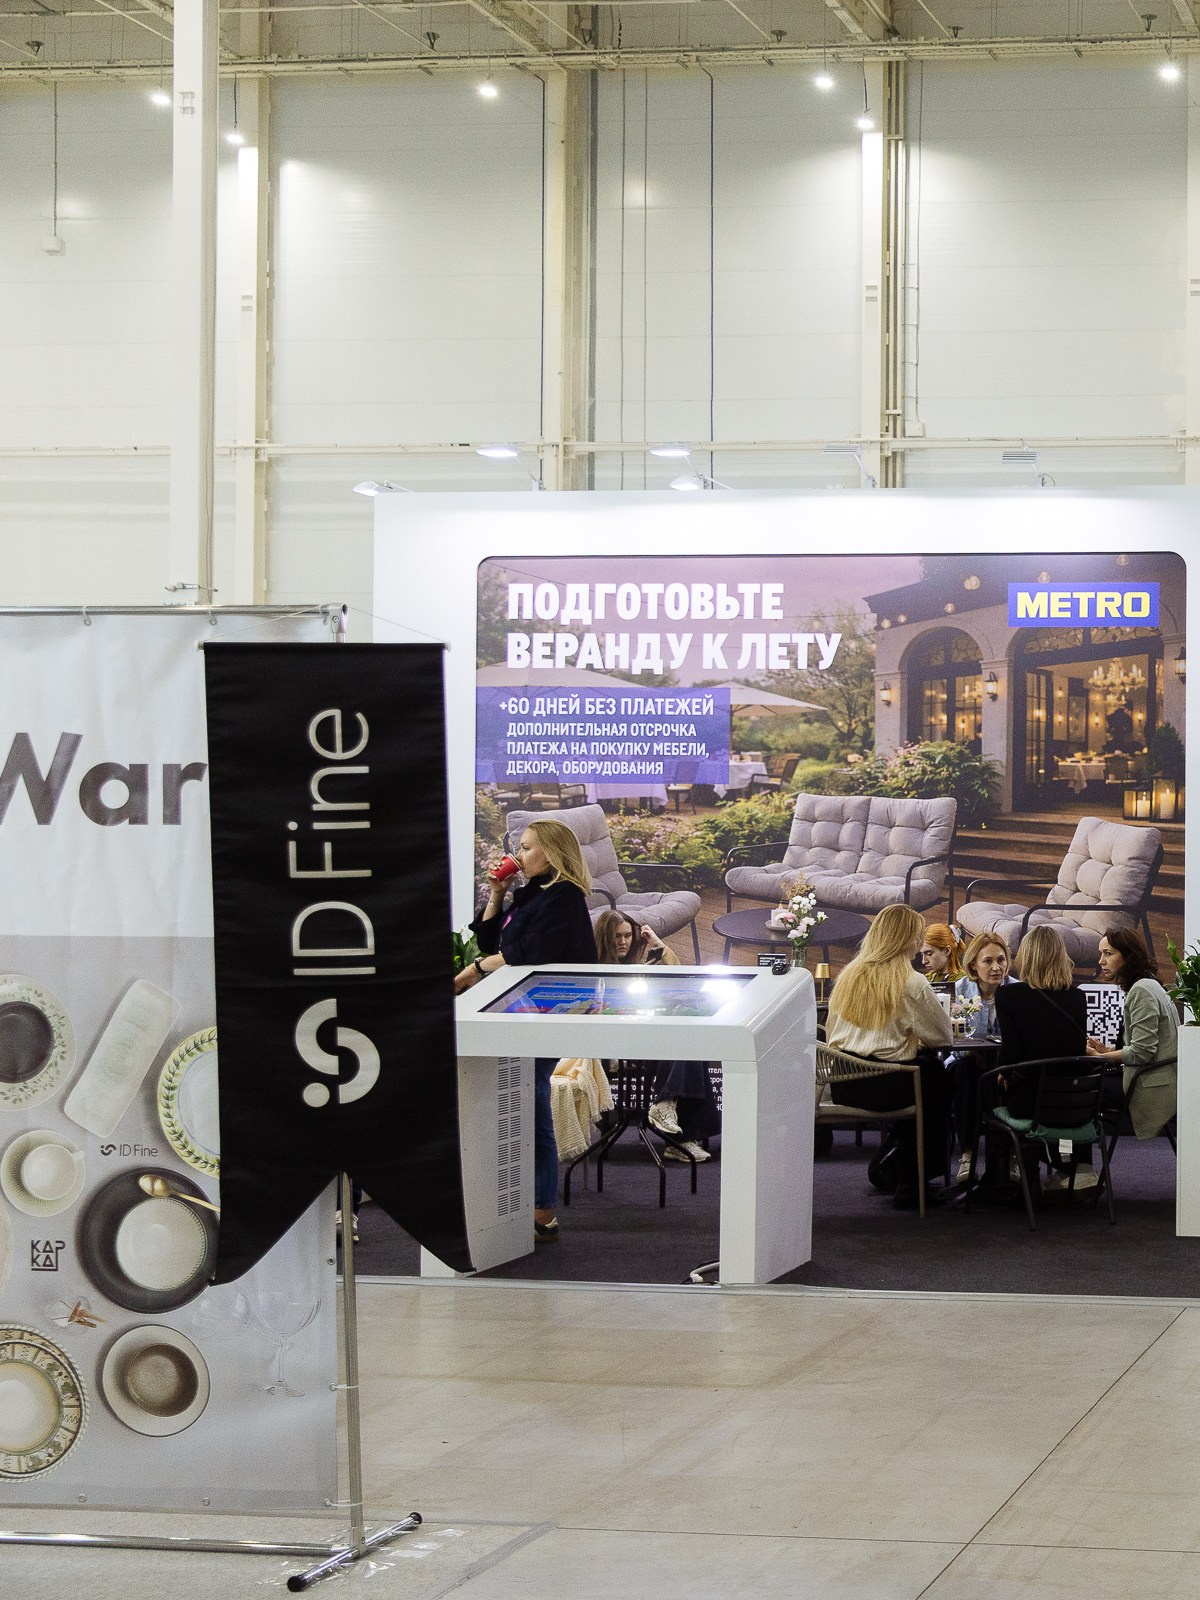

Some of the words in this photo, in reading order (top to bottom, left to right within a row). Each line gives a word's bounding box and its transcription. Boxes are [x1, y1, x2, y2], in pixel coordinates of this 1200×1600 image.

[507, 582, 784, 625] ПОДГОТОВЬТЕ
[1017, 591, 1150, 618] METRO
[506, 632, 694, 675] ВЕРАНДУ
[702, 632, 729, 670] К
[737, 632, 843, 670] ЛЕТУ
[499, 697, 530, 716] +60
[533, 694, 580, 717] ДНЕЙ
[585, 697, 616, 716] БЕЗ
[620, 694, 715, 716] ПЛАТЕЖЕЙ
[507, 722, 628, 738] ДОПОЛНИТЕЛЬНАЯ
[630, 723, 697, 737] ОТСРОЧКА
[507, 741, 568, 756] ПЛАТЕЖА
[570, 742, 588, 756] НА
[590, 742, 651, 757] ПОКУПКУ
[653, 742, 710, 759] МЕБЕЛИ,
[506, 761, 561, 777] ДЕКОРА,
[562, 761, 664, 776] ОБОРУДОВАНИЯ
[288, 708, 373, 879] Fine
[293, 900, 377, 976] ID
[119, 1144, 132, 1157] ID
[134, 1144, 159, 1158] Fine
